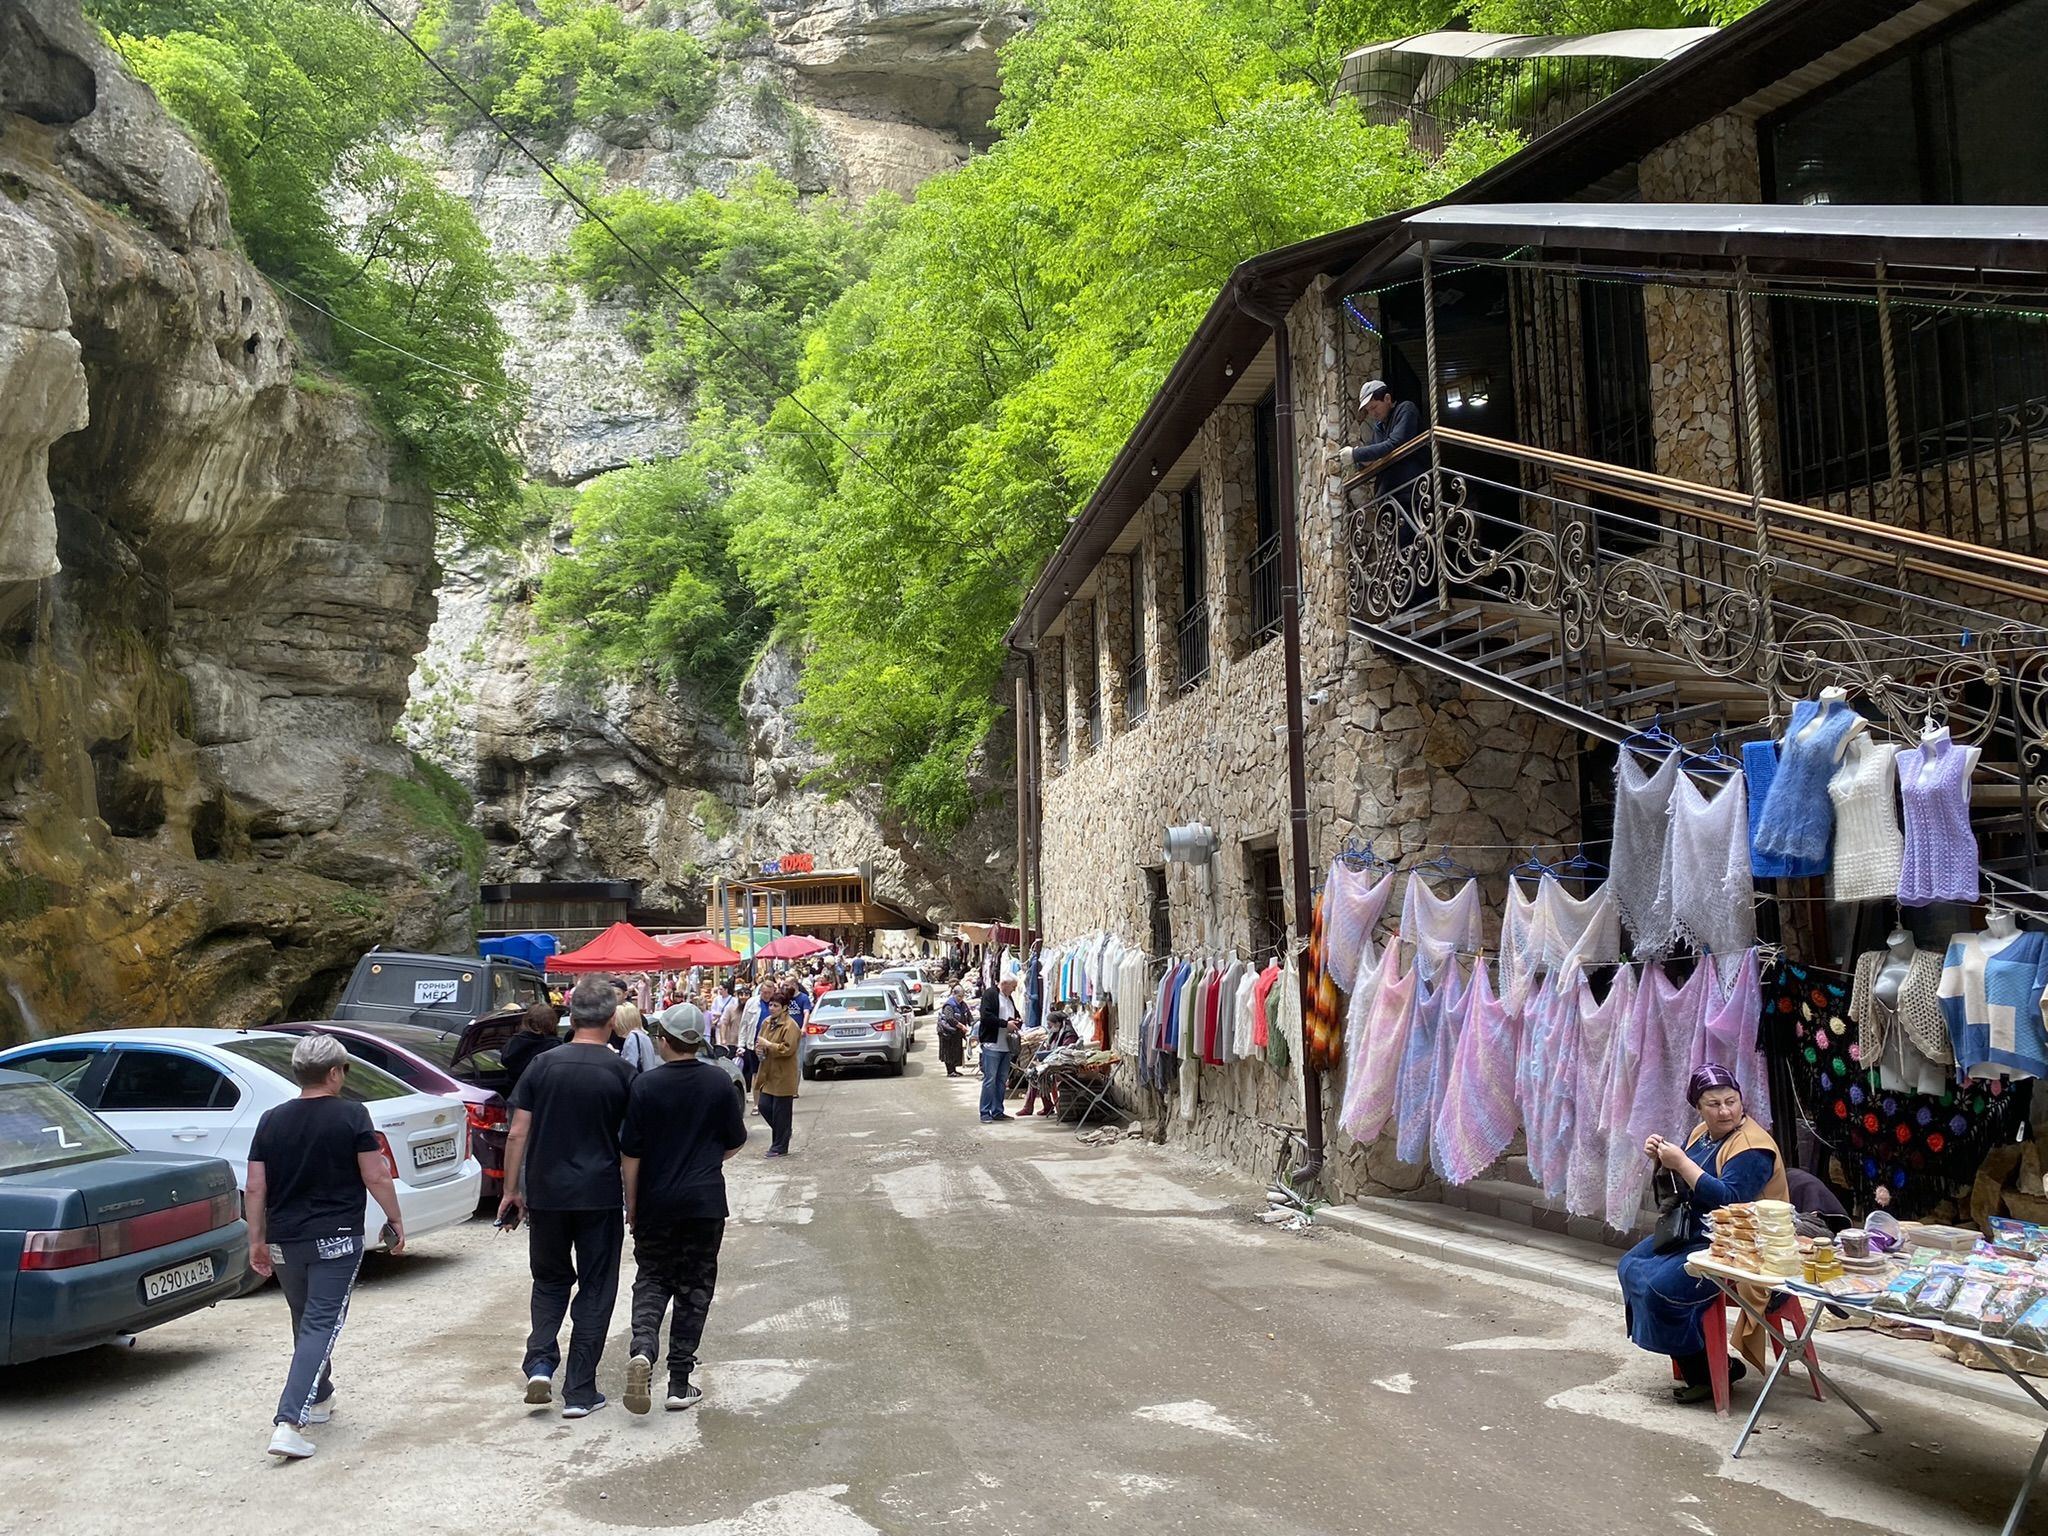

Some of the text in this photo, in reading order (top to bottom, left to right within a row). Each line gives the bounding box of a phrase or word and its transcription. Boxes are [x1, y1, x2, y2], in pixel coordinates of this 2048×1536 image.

[417, 981, 455, 990] ГОРНЫЙ
[150, 1260, 209, 1296] О290ХА 26
